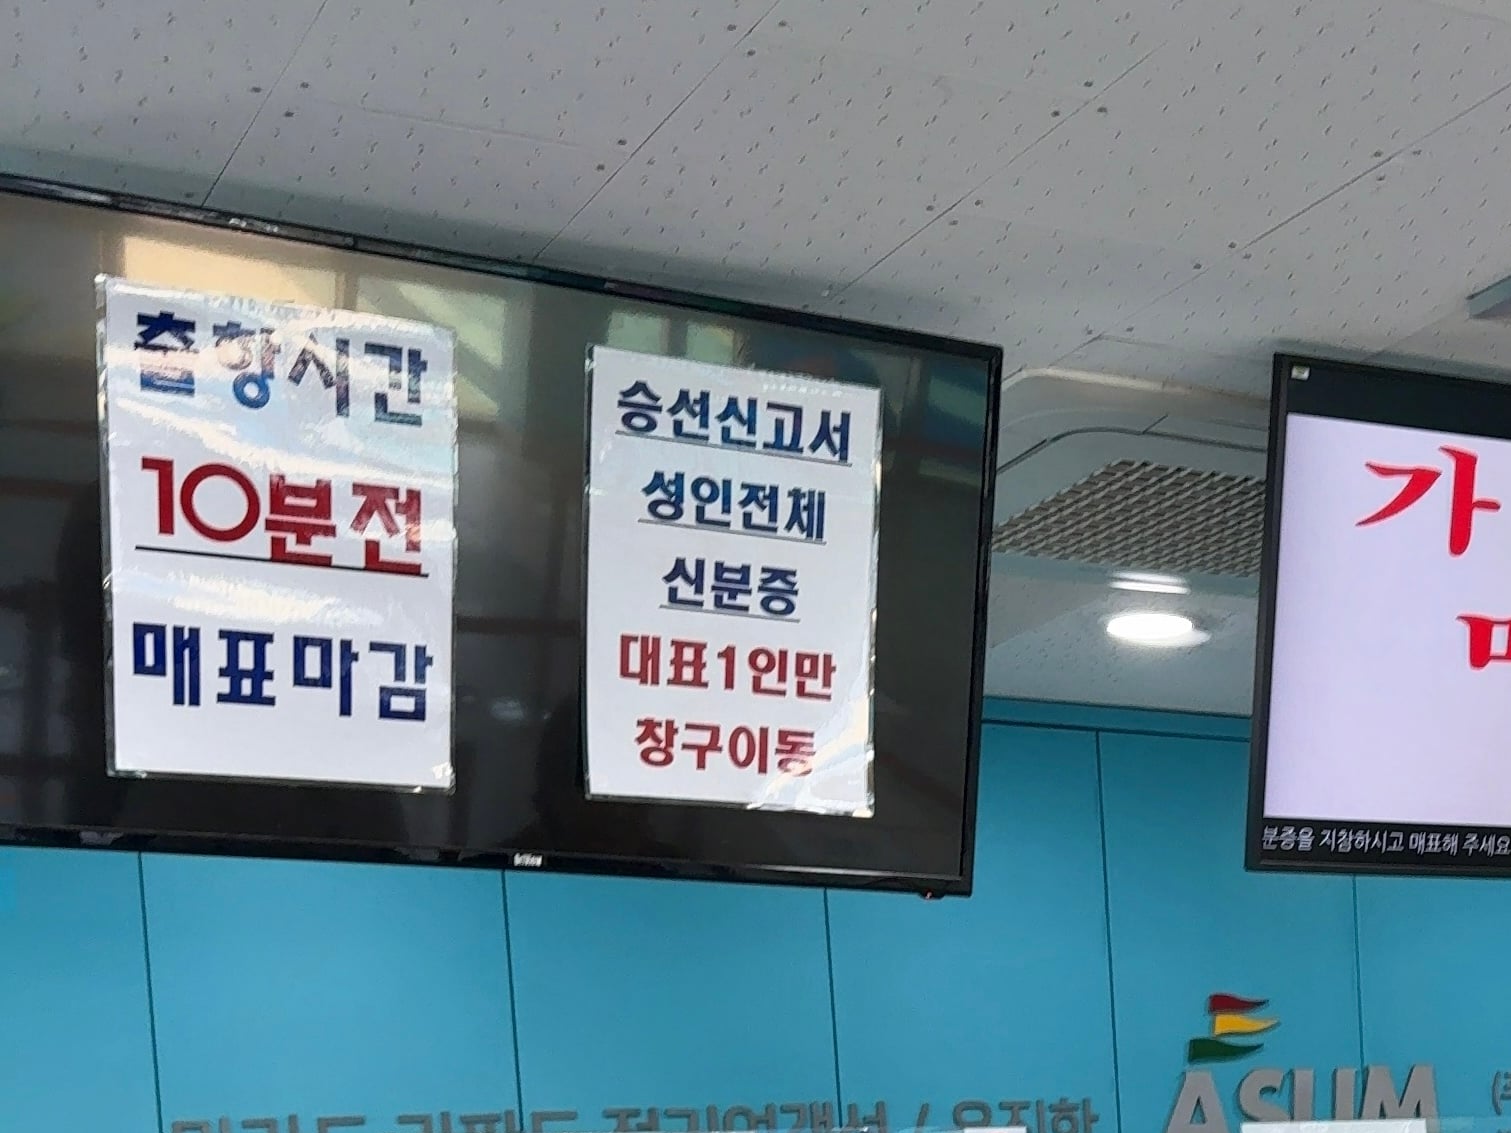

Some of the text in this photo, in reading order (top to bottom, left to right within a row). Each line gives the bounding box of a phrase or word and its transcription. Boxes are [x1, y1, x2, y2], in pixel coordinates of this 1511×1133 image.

[136, 310, 428, 427] 출항시간
[616, 381, 852, 462] 승선신고서
[141, 456, 424, 576] 10분전
[641, 470, 827, 543] 성인전체
[662, 558, 799, 617] 신분증
[131, 623, 433, 723] 매표마감
[619, 634, 836, 701] 대표1인만
[634, 719, 816, 777] 창구이동
[1262, 826, 1315, 851] 분증을
[1319, 828, 1404, 853] 지참하시고
[1409, 832, 1459, 856] 매표해
